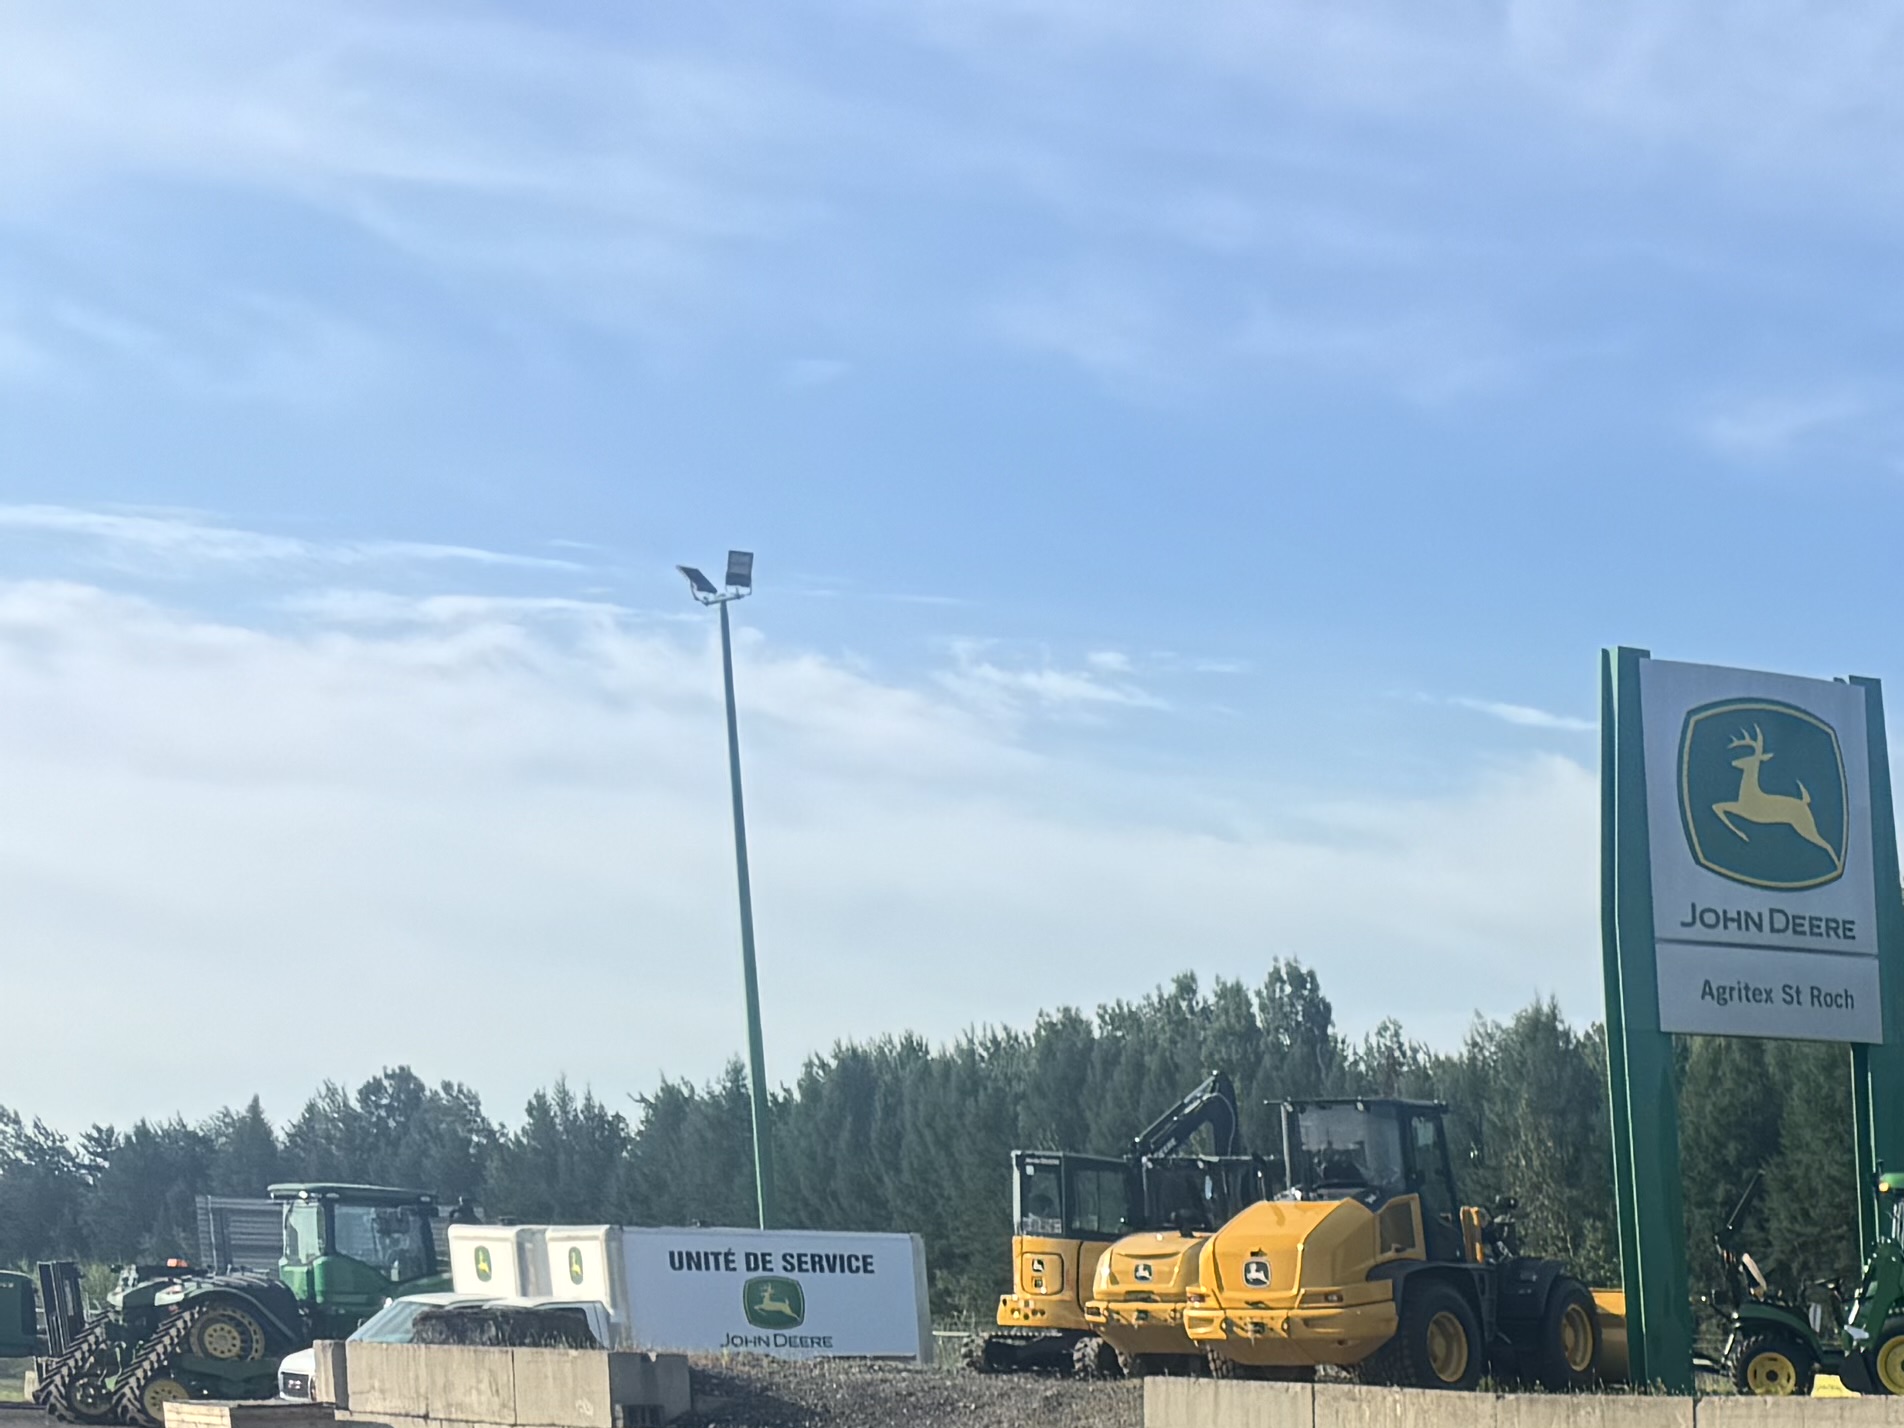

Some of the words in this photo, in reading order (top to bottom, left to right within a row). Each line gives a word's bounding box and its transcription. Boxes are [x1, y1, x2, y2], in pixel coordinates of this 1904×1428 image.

[1680, 902, 1763, 933] JOHN
[1769, 908, 1856, 941] DEERE
[1701, 979, 1774, 1006] Agritex
[1781, 984, 1803, 1006] St
[1810, 986, 1855, 1010] Roch
[668, 1248, 737, 1272] UNITÉ
[745, 1251, 775, 1273] DE
[782, 1252, 875, 1274] SERVICE
[720, 1333, 770, 1348] JOHN
[773, 1333, 833, 1348] DEERE
